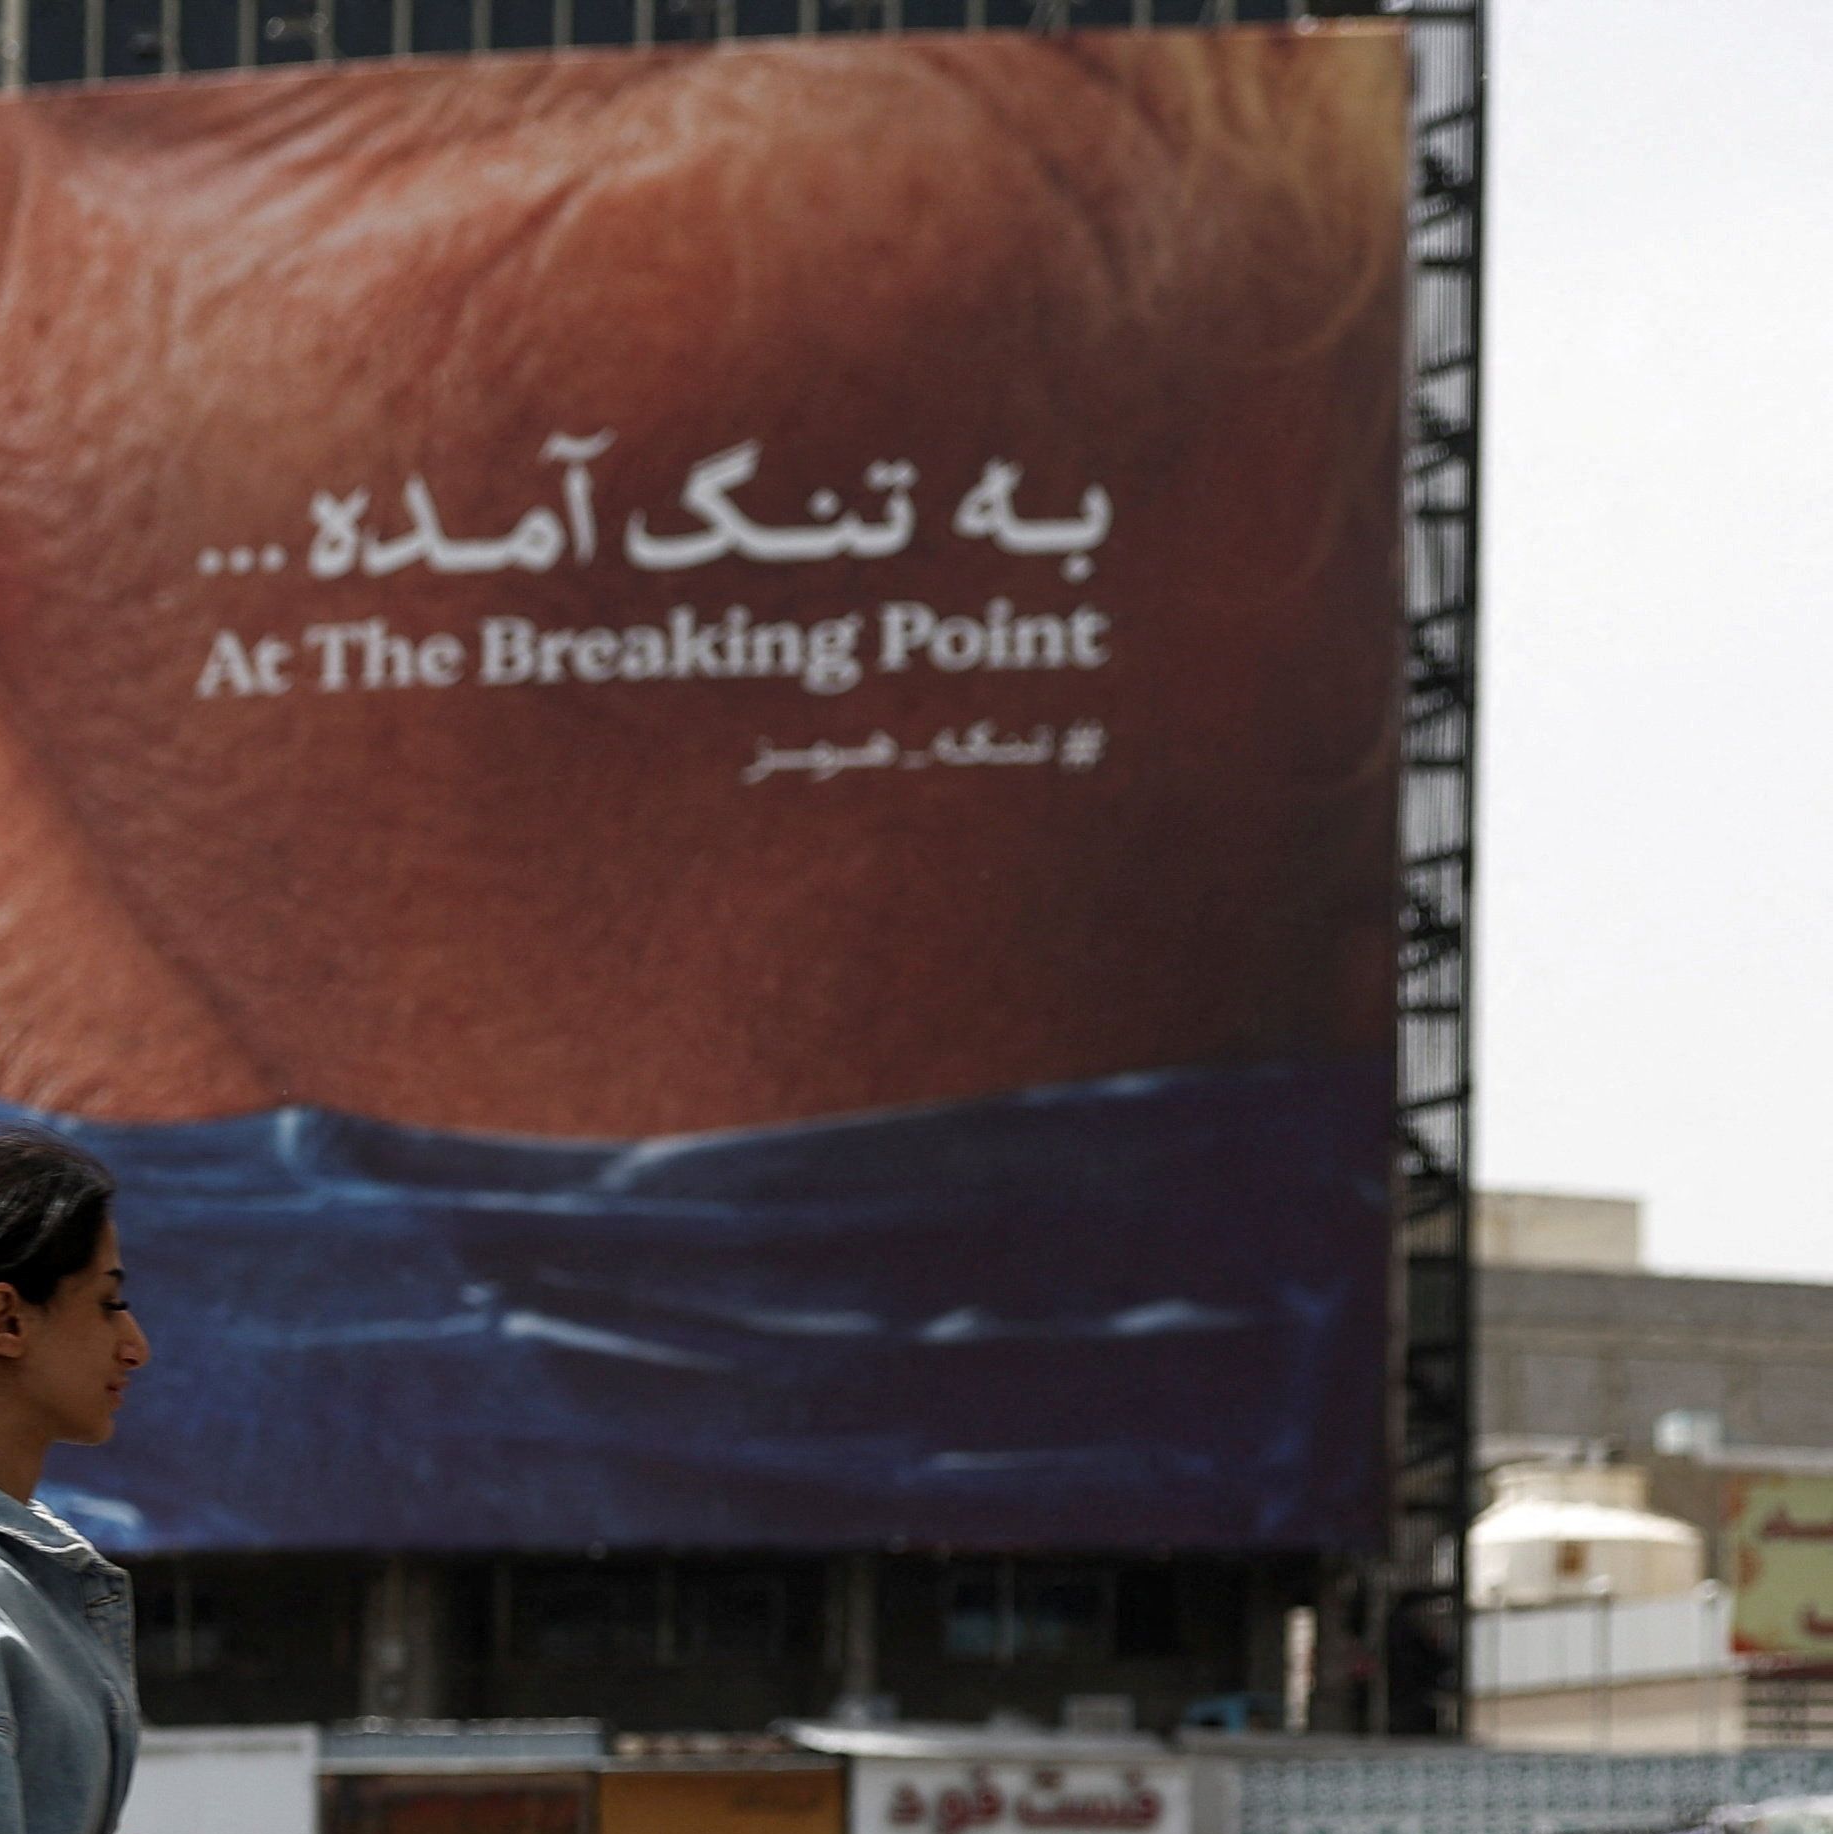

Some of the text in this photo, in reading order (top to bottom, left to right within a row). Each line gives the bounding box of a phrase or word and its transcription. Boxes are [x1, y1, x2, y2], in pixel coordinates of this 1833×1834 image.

[954, 461, 1113, 582] به
[196, 597, 1108, 699] At The Breaking Point
